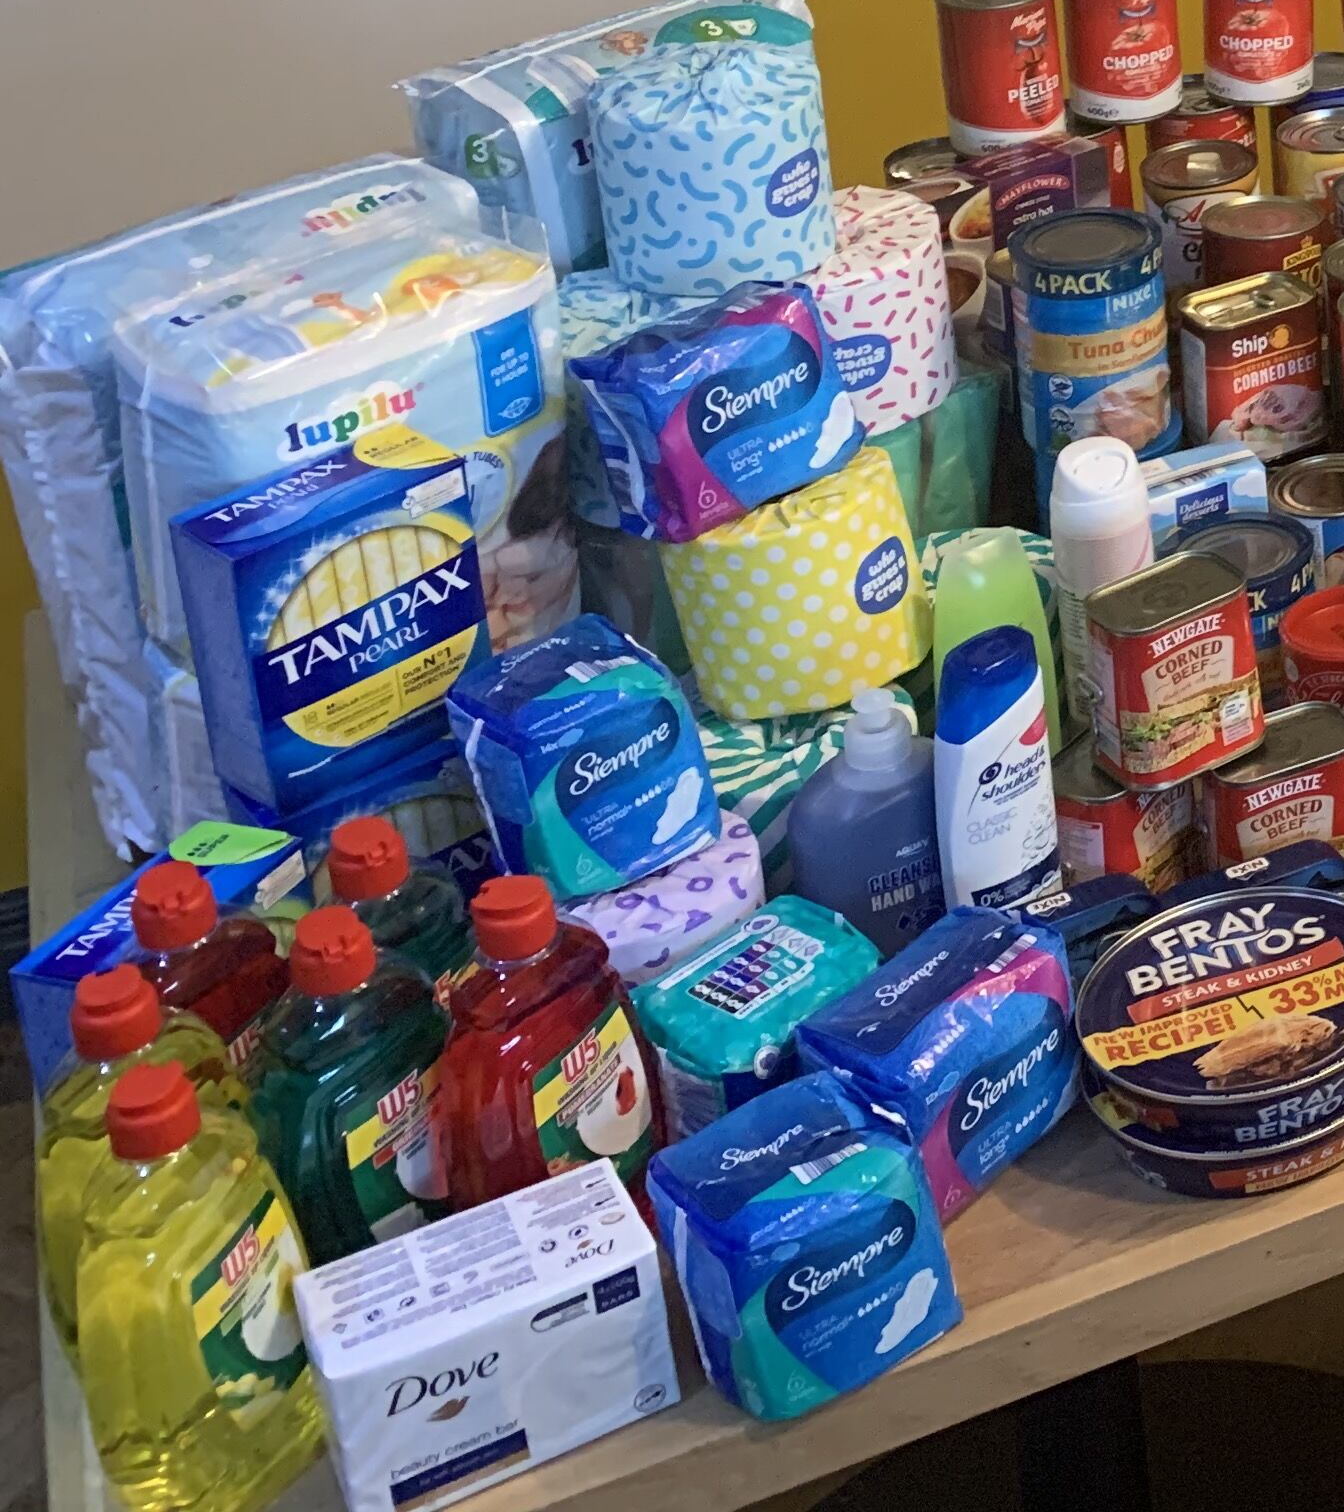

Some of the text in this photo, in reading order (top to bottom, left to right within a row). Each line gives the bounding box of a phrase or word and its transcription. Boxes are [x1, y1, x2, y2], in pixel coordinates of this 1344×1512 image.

[1219, 34, 1294, 53] CHOPPED
[1006, 75, 1061, 104] PEELED
[1068, 341, 1125, 361] Tuna
[1231, 335, 1269, 359] Ship
[1232, 351, 1319, 395] CORNED BEEF
[700, 360, 810, 436] Siempre
[205, 458, 347, 524] TAMPAX
[268, 557, 472, 686] TAMPAX
[1150, 613, 1224, 658] NEWGATE
[1155, 638, 1224, 680] CORNED
[1170, 658, 1211, 686] BEEF
[966, 806, 1019, 835] CLASSIC
[967, 823, 1013, 846] CLEAN
[1249, 798, 1323, 834] CORNED
[870, 882, 916, 913] HAND
[1161, 954, 1316, 1009] STEAK & KIDNEY
[384, 1351, 501, 1419] Dove
[390, 1418, 520, 1481] beauty cream bar
